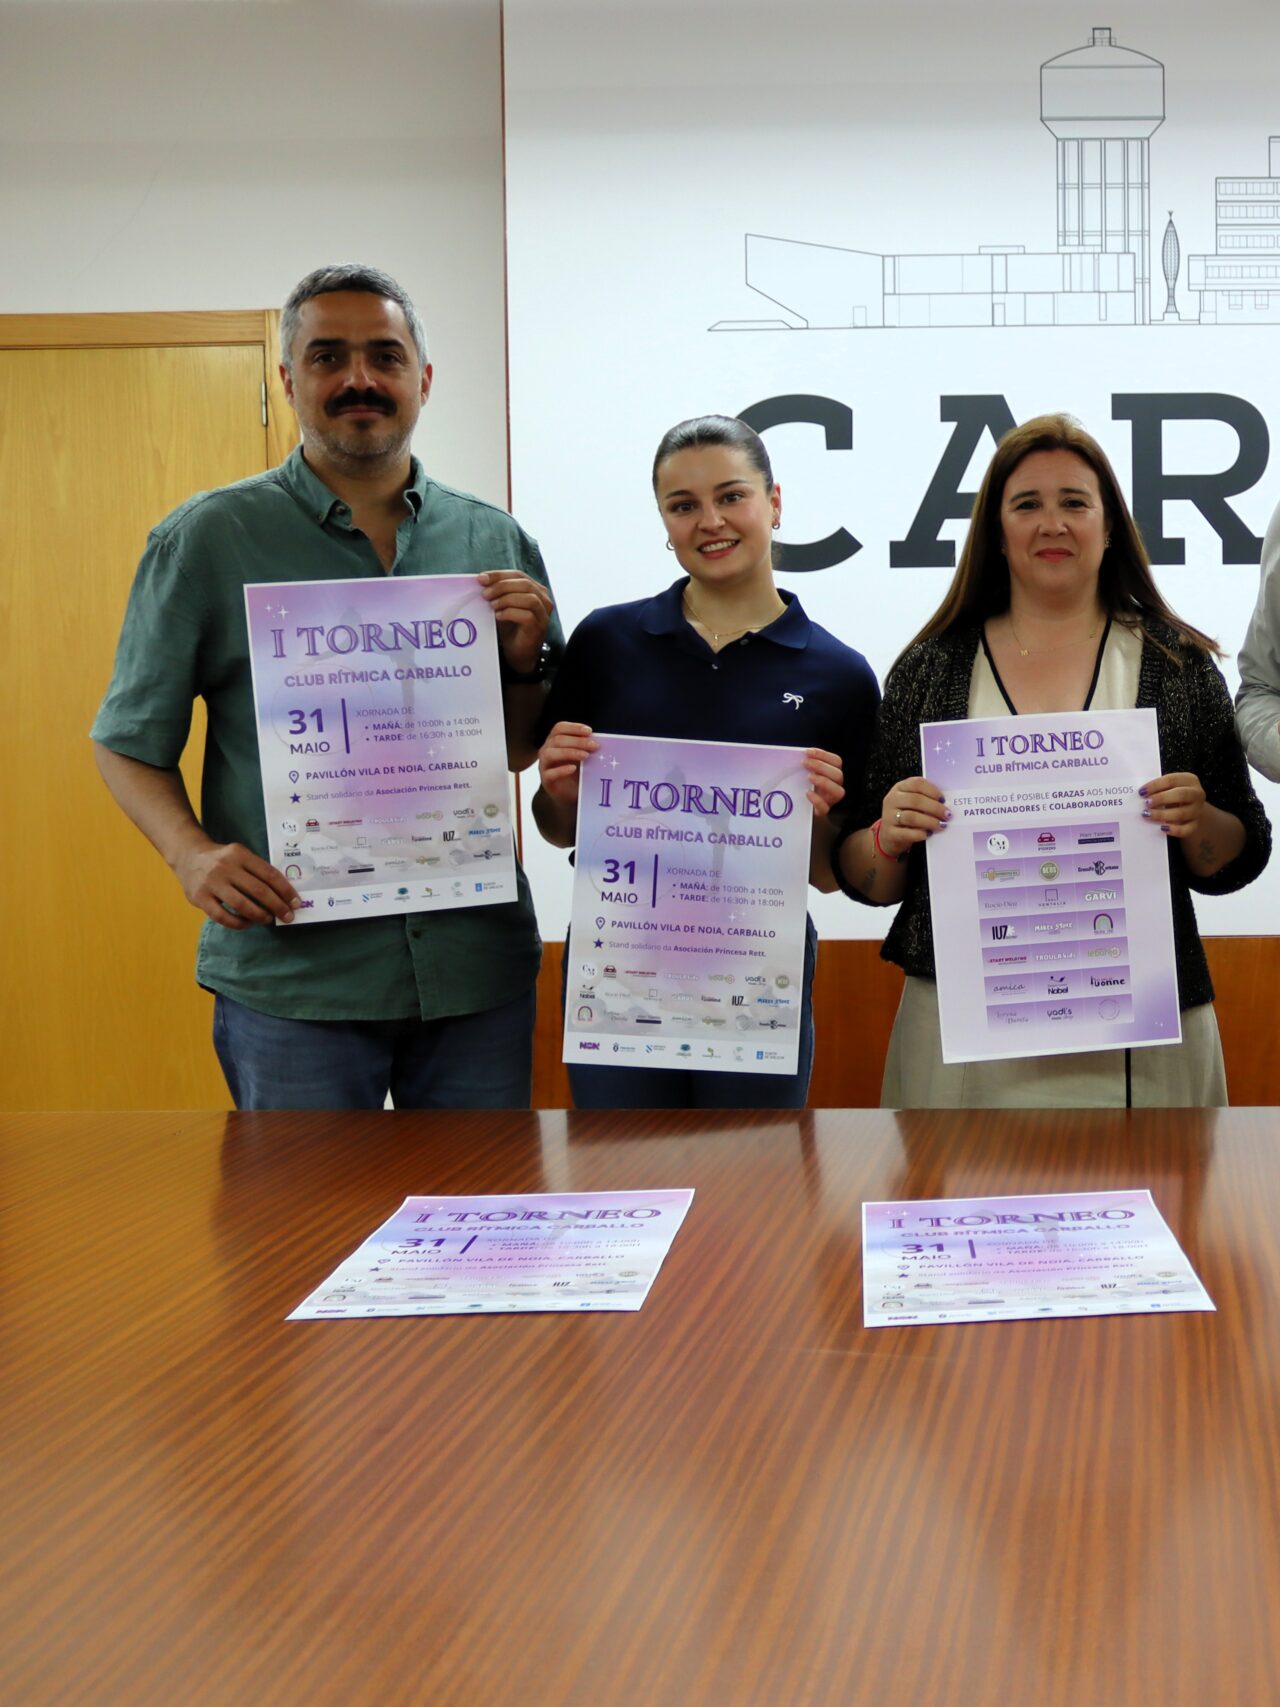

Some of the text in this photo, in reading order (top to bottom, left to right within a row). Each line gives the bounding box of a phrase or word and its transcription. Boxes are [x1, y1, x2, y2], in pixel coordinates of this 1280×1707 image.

[270, 618, 477, 658] I TORNEO
[284, 665, 472, 688] CLUB RÍTMICA CARBALLO
[288, 708, 324, 735] 31
[372, 721, 401, 730] MAÑÁ:
[404, 721, 415, 729] de
[417, 720, 444, 728] 10:00h
[453, 717, 480, 725] 14:00h
[374, 733, 402, 742] TARDE:
[419, 731, 446, 740] 16:30h
[455, 728, 482, 737] 18:00H
[976, 730, 1104, 757] I TORNEO
[290, 741, 330, 754] MAIO
[306, 760, 478, 780] PAVILLÓN VILA DE NOIA, CARBALLO
[974, 756, 1108, 774] CLUB RÍTMICA CARBALLO
[599, 778, 793, 819] I TORNEO
[953, 786, 1134, 806] ESTE TORNEO É POSIBLE GRAZAS AOS NOSOS
[964, 804, 1040, 816] PATROCINADORES
[1049, 798, 1123, 810] COLABORADORES
[605, 826, 783, 848] CLUB RÍTMICA CARBALLO
[603, 858, 636, 884] 31
[601, 891, 638, 904] MAIO
[680, 882, 706, 890] MAÑÁ:
[710, 884, 720, 892] de
[722, 884, 748, 893] 10:00h
[758, 888, 784, 896] 14:00h
[1084, 890, 1117, 901] GARVI
[680, 893, 706, 902] TARDE:
[722, 896, 748, 904] 16:30h
[758, 898, 785, 907] 18:00H
[612, 920, 776, 938] PAVILLÓN VILA DE NOIA, CARBALLO
[413, 1208, 662, 1224] I TORNEO
[890, 1210, 1136, 1228] I TORNEO
[953, 1228, 1028, 1236] RÍTMICA
[1034, 1224, 1130, 1232] CARBALLO
[398, 1238, 446, 1248] 31
[902, 1244, 944, 1254] 31
